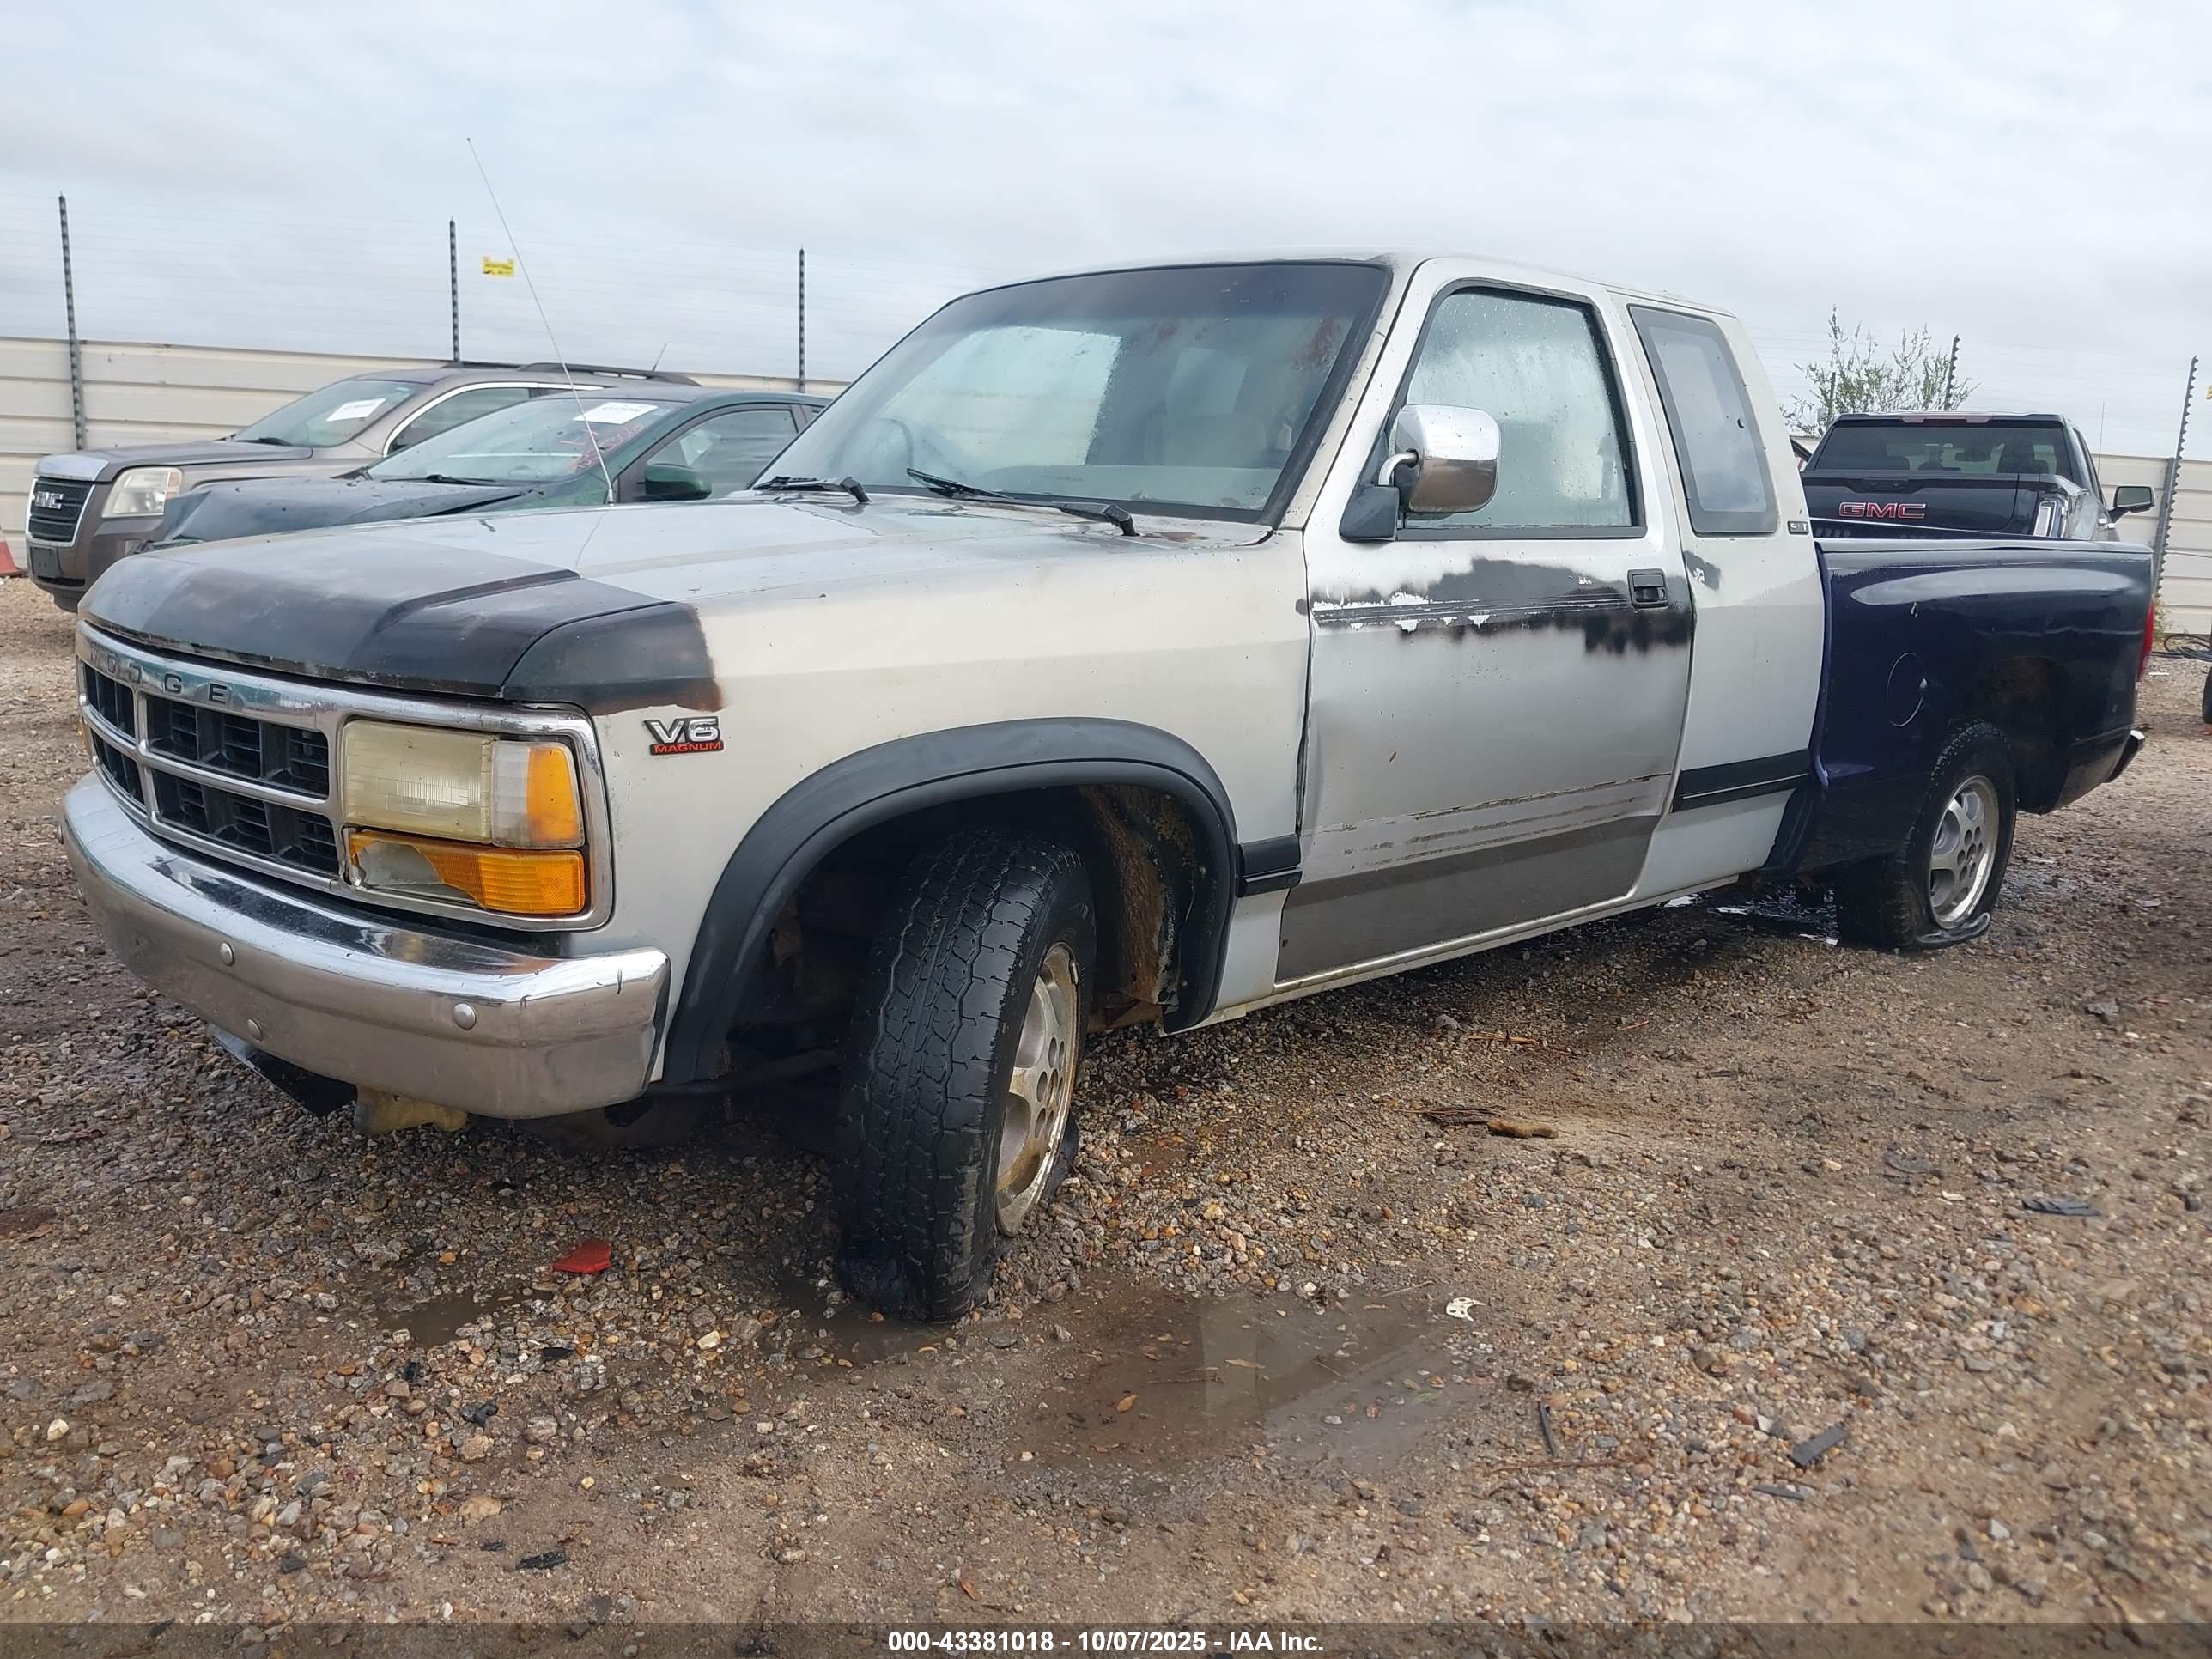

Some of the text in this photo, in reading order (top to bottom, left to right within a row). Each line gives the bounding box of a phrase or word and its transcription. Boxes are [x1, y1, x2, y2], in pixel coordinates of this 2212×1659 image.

[1839, 501, 1926, 519] GMC
[648, 718, 720, 744] V6
[653, 742, 722, 754] MAGNUM
